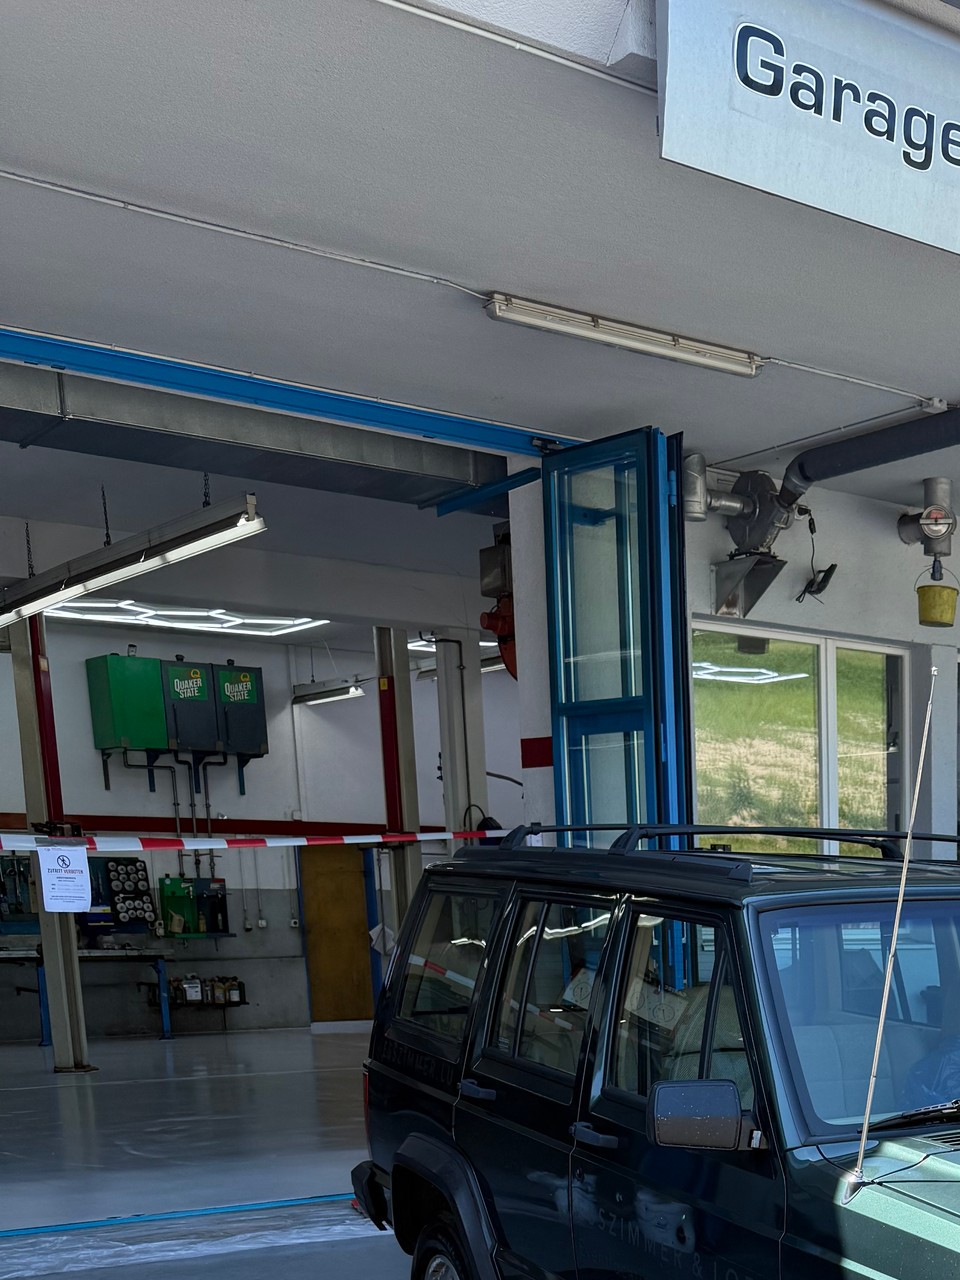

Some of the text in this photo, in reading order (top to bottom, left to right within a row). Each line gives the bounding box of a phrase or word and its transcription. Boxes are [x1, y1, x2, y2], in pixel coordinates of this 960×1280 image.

[174, 678, 202, 692] QUAKER
[225, 682, 251, 696] QUAKER
[180, 688, 200, 699] STATE
[229, 691, 249, 702] STATE
[691, 1252, 704, 1280] &
